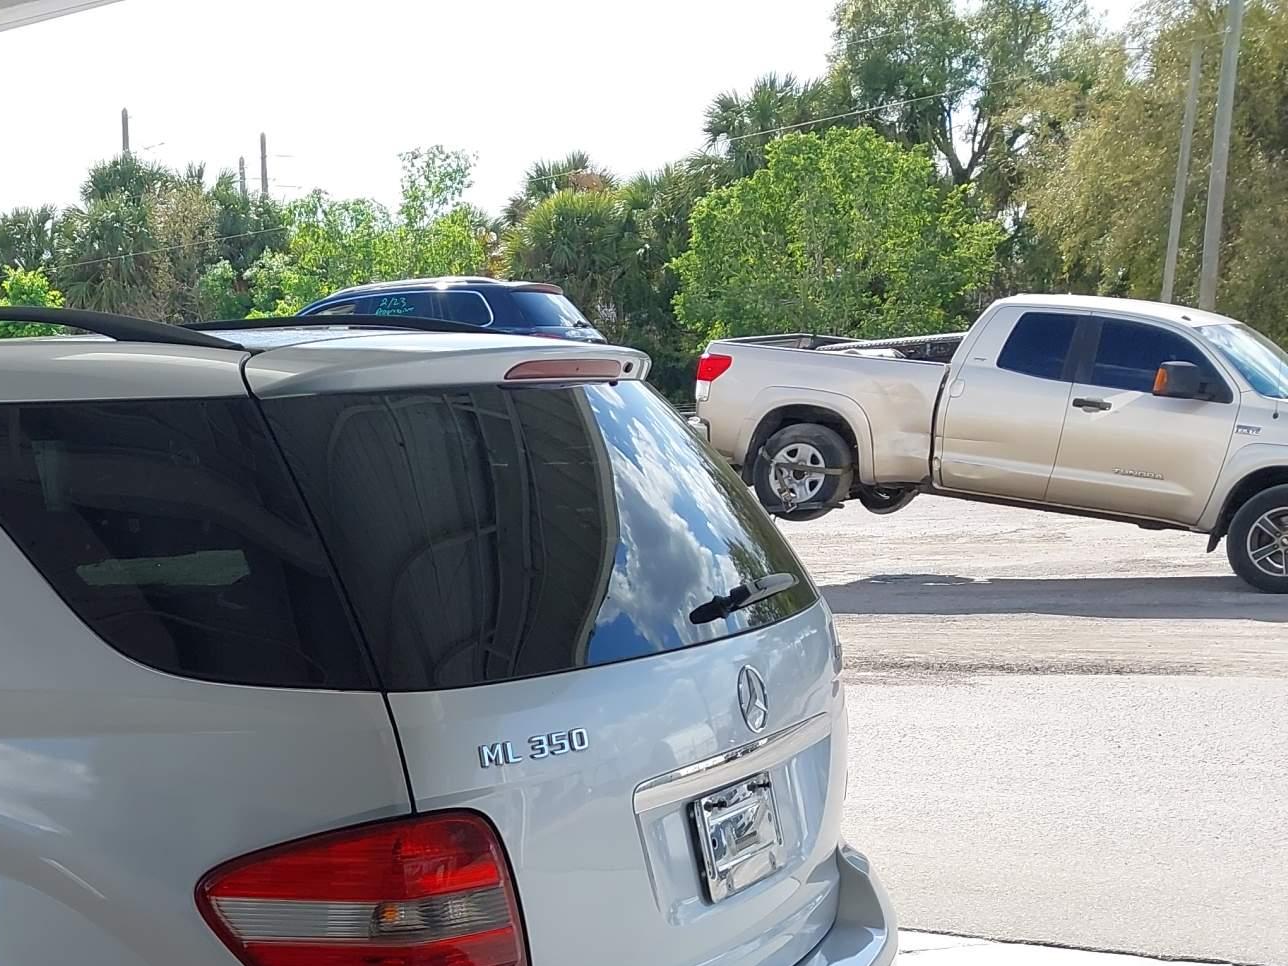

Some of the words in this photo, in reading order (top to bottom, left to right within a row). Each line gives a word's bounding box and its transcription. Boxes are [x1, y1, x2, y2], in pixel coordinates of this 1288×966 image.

[379, 297, 407, 307] 2/23
[1112, 468, 1163, 480] TUNDRA
[478, 741, 523, 769] ML
[528, 727, 589, 760] 350
